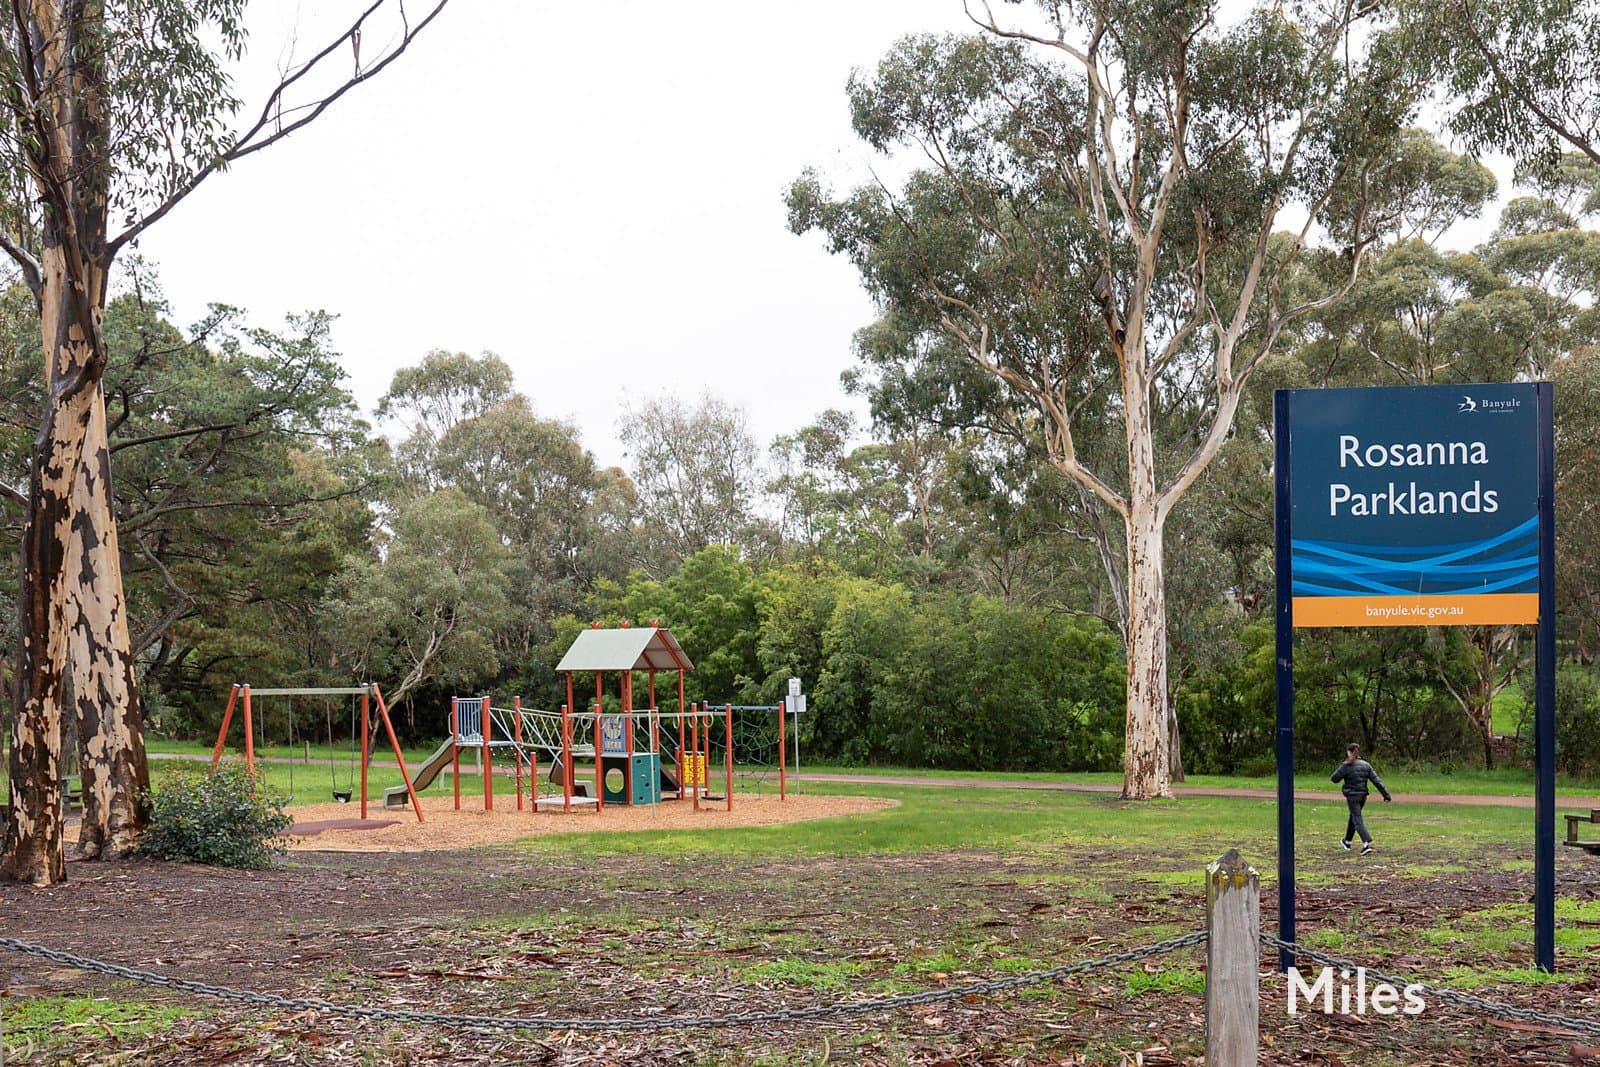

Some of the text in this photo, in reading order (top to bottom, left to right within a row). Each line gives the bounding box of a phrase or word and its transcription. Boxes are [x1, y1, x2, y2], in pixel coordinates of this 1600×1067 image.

[1482, 398, 1521, 409] Banyule
[1339, 434, 1489, 468] Rosanna
[1329, 480, 1499, 516] Parklands
[1366, 605, 1464, 619] banyule.vic.gov.au
